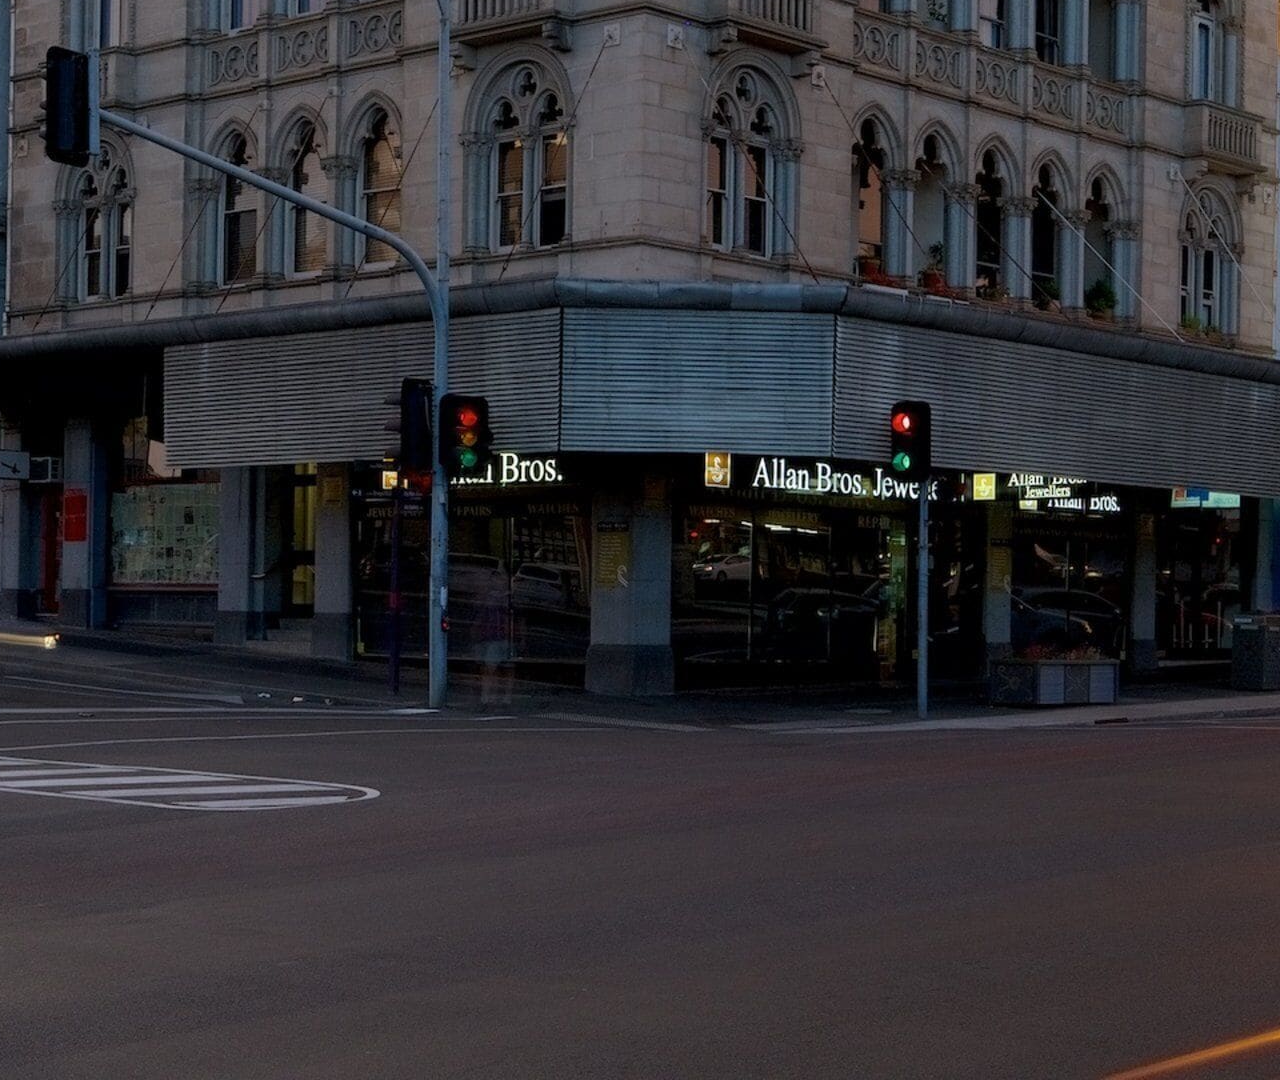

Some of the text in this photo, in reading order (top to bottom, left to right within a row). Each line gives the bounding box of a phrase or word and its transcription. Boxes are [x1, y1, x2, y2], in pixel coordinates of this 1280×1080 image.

[499, 452, 563, 483] Bros.
[752, 457, 810, 491] Allan
[816, 462, 867, 496] Bros.
[1007, 472, 1044, 487] Allan
[1024, 486, 1071, 499] Jewellers
[1089, 495, 1121, 512] Bros.
